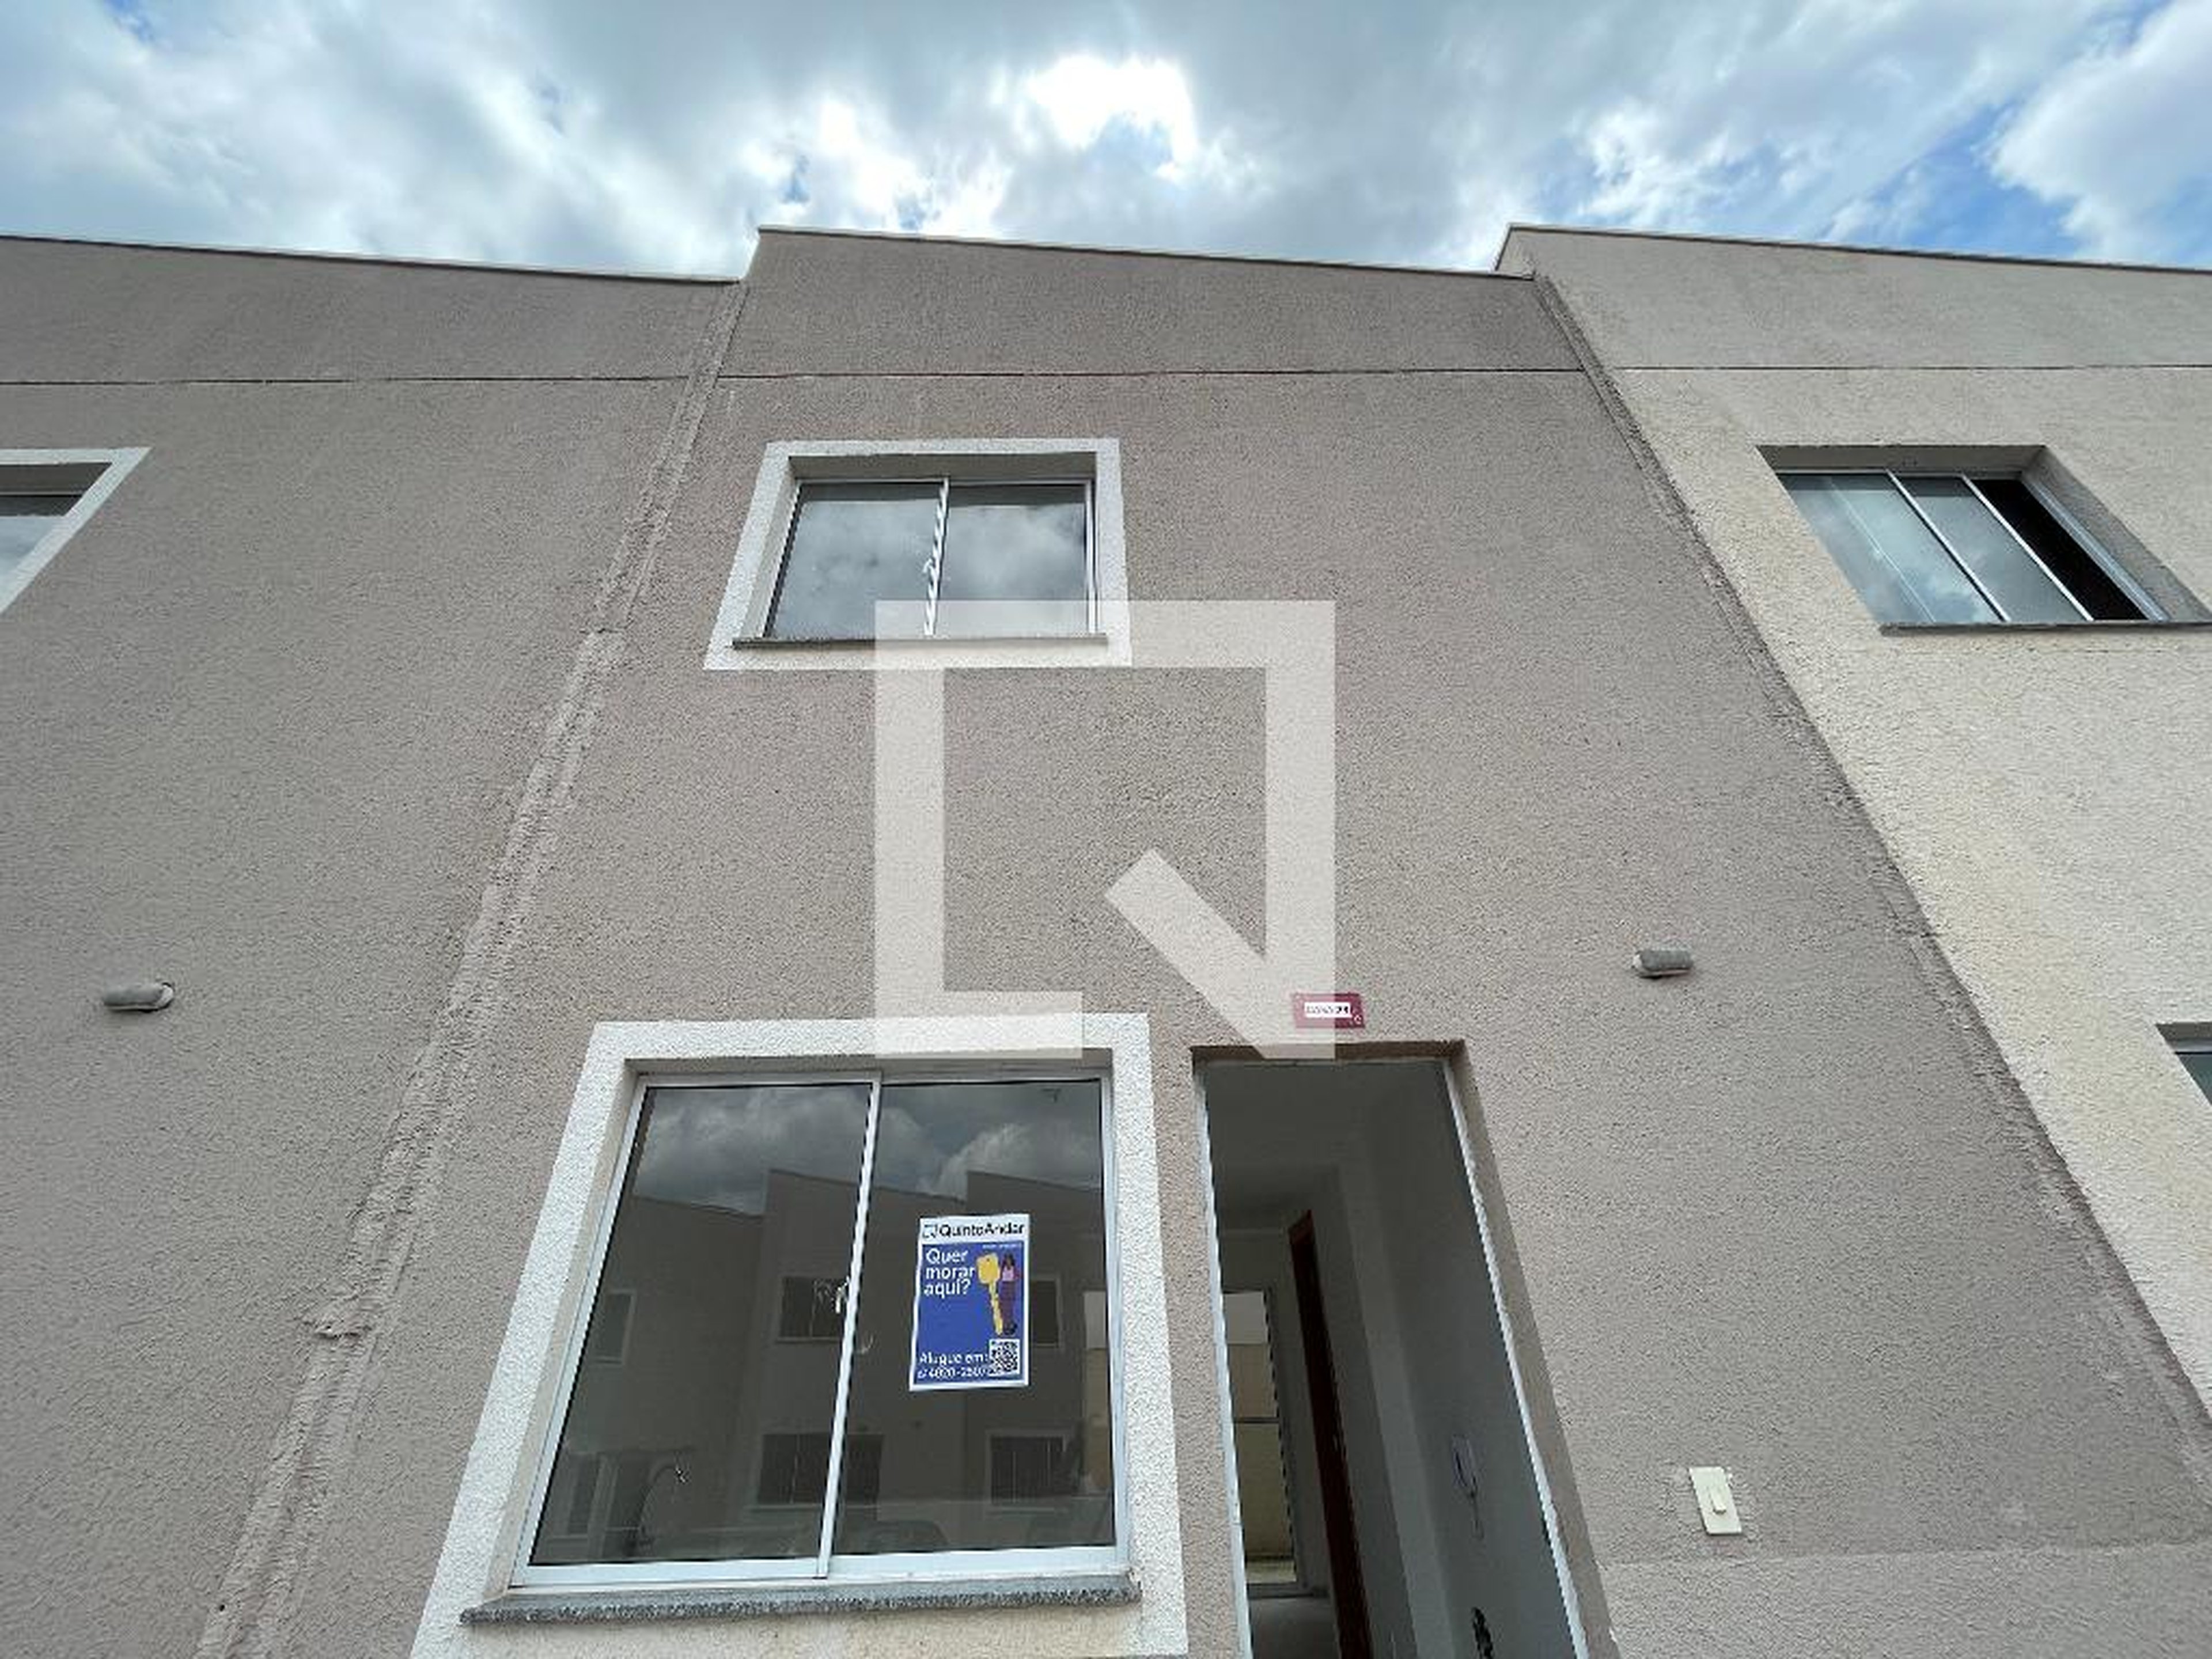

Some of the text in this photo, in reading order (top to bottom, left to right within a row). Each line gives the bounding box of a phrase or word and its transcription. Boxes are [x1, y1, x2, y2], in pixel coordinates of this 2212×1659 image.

[938, 1222, 1025, 1237] QuintoAndar
[925, 1247, 968, 1264] Quer
[925, 1266, 975, 1279] morar
[923, 1279, 971, 1298] aqui?
